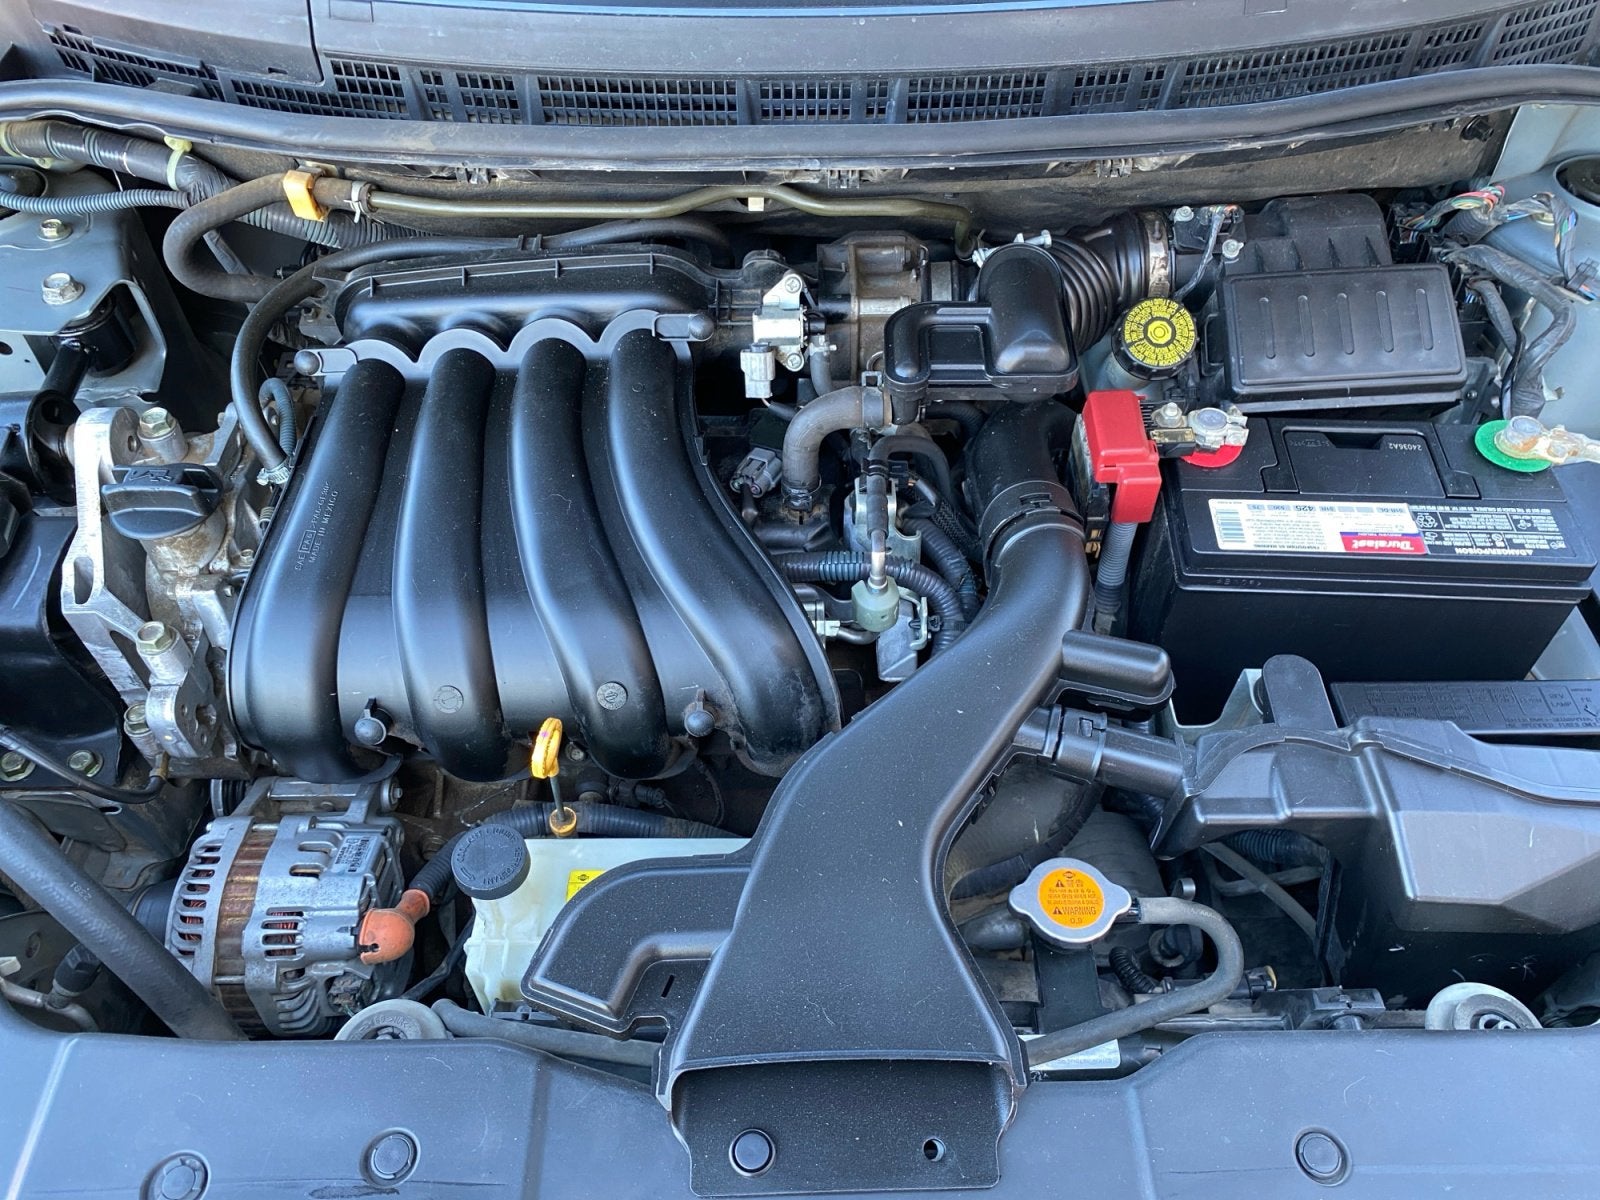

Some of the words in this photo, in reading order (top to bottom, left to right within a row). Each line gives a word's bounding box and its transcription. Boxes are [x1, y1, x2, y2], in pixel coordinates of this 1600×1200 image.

[321, 490, 339, 526] MEXICO
[317, 527, 327, 537] IN
[1351, 539, 1414, 551] Duralast
[308, 540, 322, 563] MADE
[1062, 906, 1097, 915] WARNING
